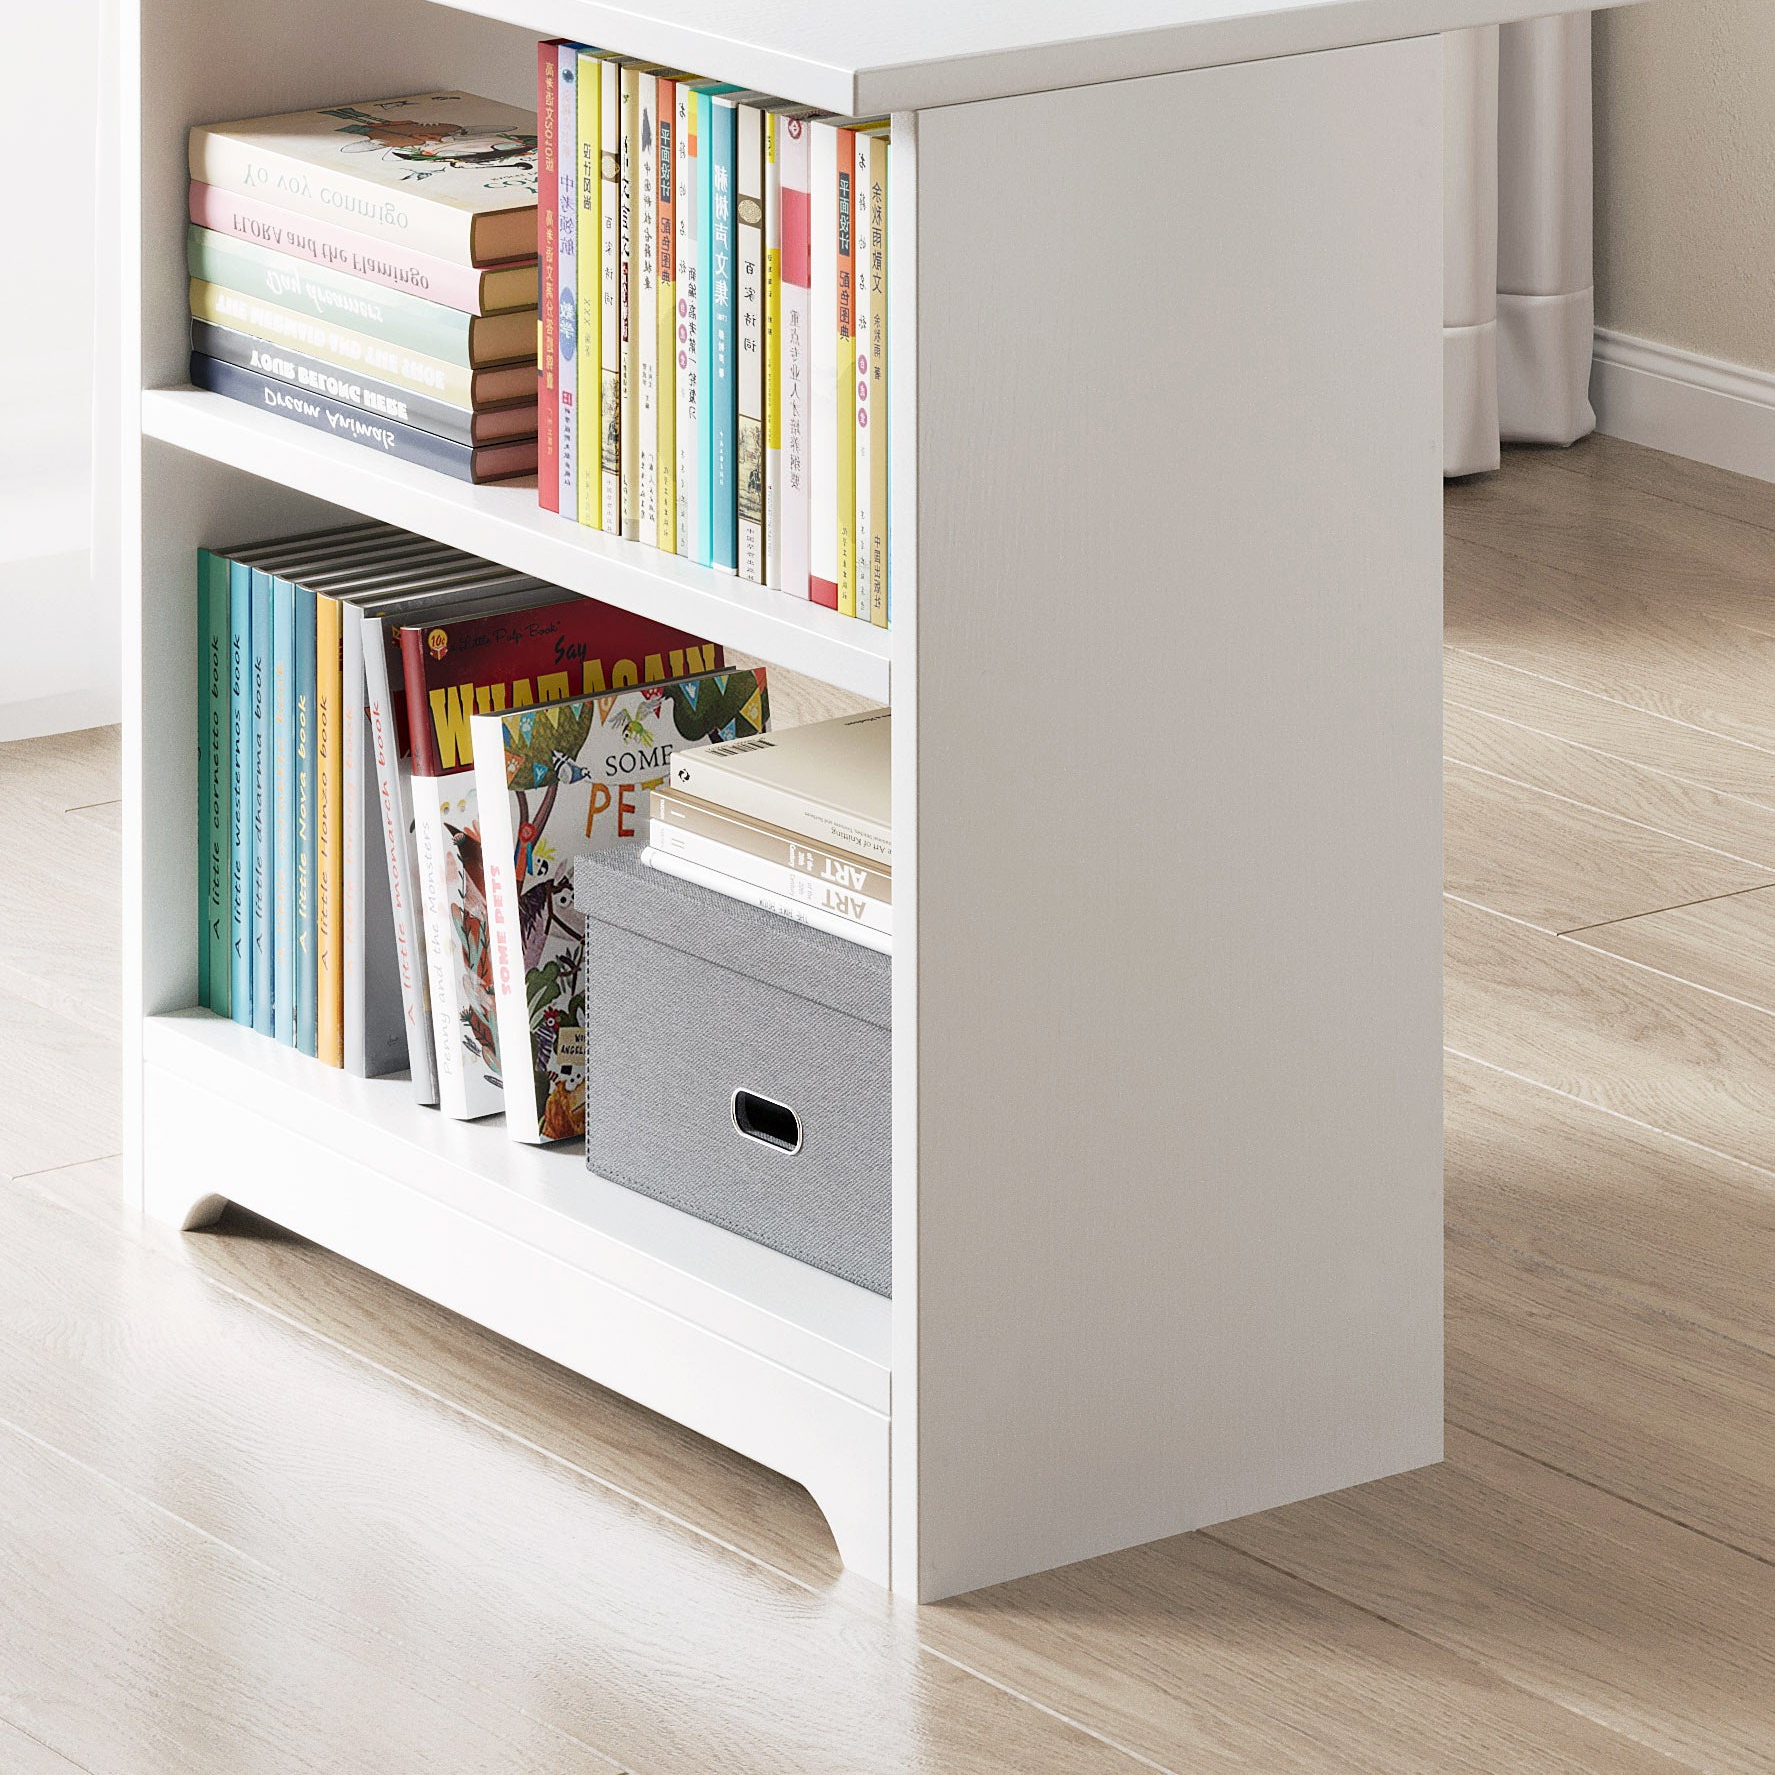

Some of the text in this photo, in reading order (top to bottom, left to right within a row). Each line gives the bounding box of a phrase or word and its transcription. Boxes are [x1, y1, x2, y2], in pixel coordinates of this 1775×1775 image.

[232, 632, 243, 697] book
[554, 635, 588, 666] Say
[319, 695, 329, 760] book
[605, 744, 674, 776] SOME
[210, 633, 221, 940] A little cornetto book
[253, 655, 264, 955] A little dharma book
[298, 694, 308, 955] A little Nova book
[831, 826, 862, 846] Knitting
[234, 862, 243, 924] little
[371, 699, 417, 1026] A little monarch book
[820, 858, 869, 891] ART
[319, 869, 329, 937] little
[491, 864, 512, 997] SOME PETS
[820, 888, 868, 920] ART
[234, 937, 243, 959] A
[320, 949, 329, 972] A
[421, 821, 453, 1077] Penny and the Monsters
